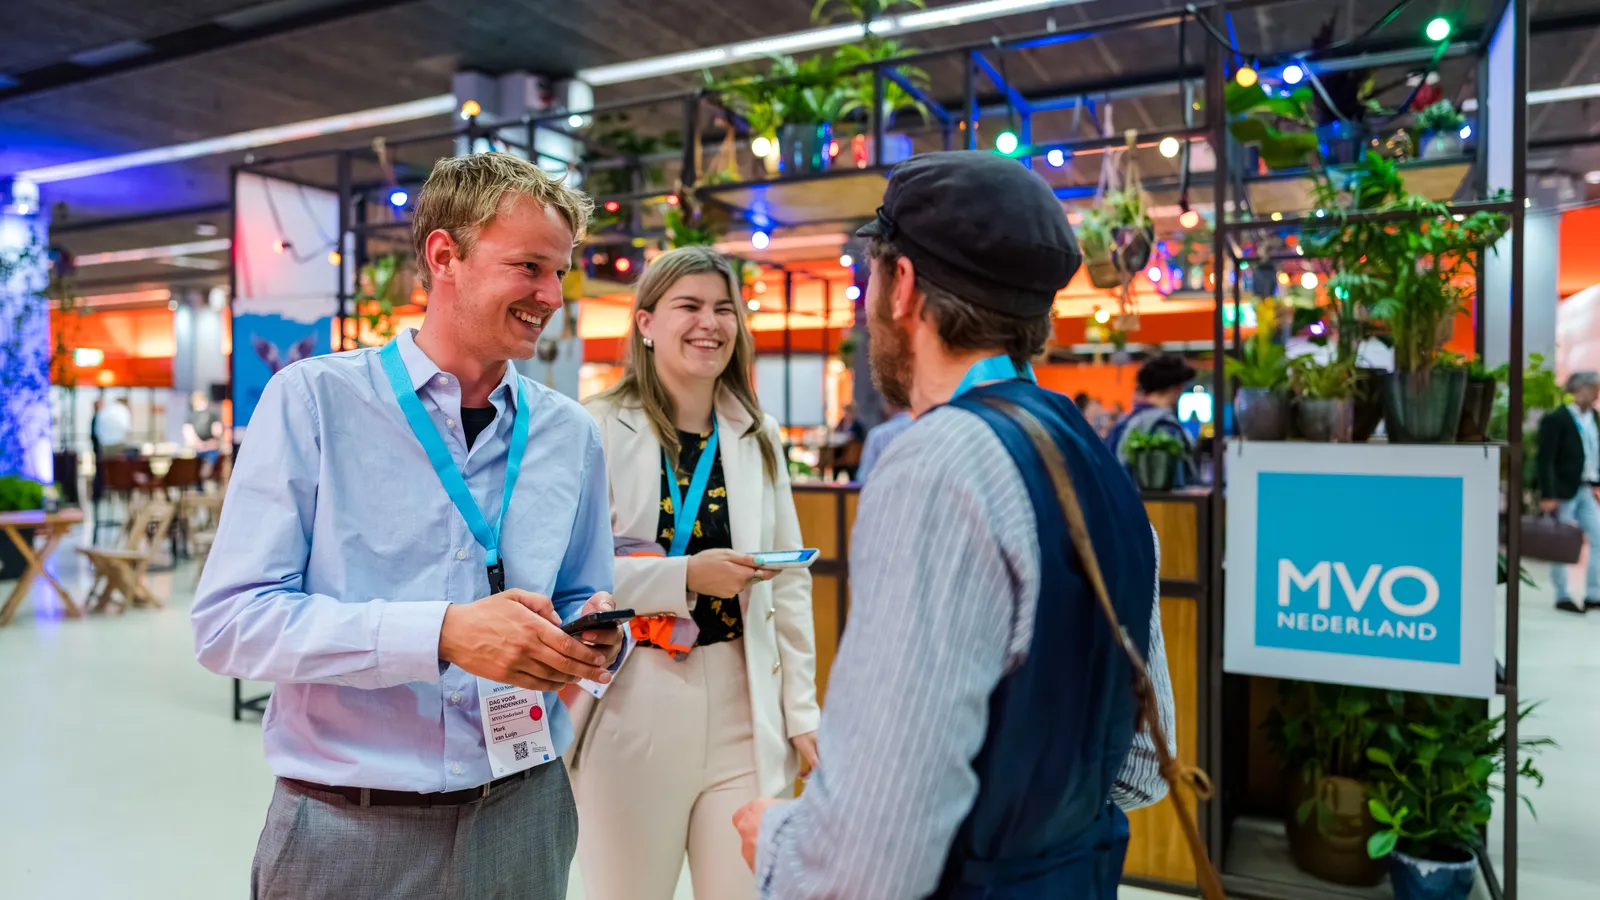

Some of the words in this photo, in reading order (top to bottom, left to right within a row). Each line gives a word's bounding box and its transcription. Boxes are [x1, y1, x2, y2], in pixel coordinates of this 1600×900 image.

[1277, 558, 1440, 617] MVO
[1277, 611, 1438, 641] NEDERLAND
[490, 698, 528, 712] DOENDENKERS
[501, 695, 516, 703] VOOR
[502, 710, 524, 719] Nederland
